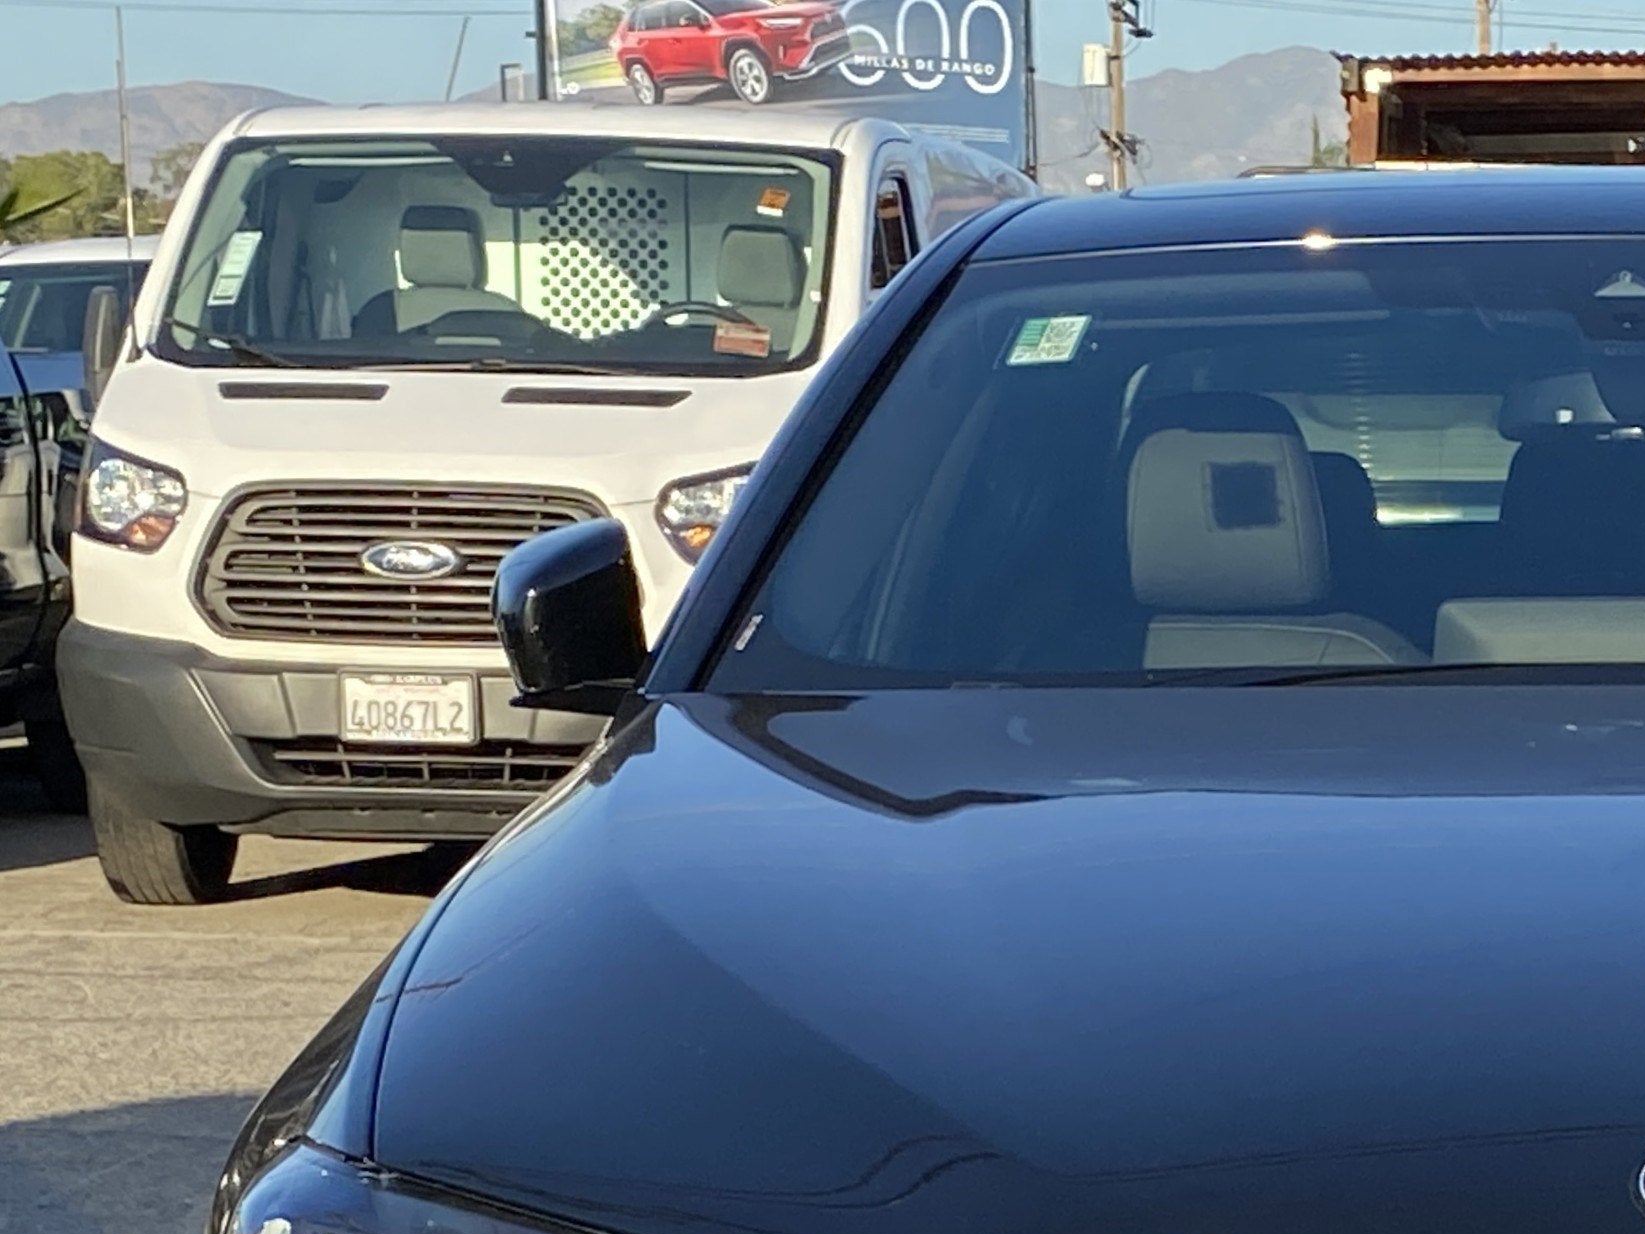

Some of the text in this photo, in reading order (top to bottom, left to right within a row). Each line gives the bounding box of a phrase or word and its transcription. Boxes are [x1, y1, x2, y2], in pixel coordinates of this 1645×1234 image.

[854, 54, 996, 76] MILLAS DE RANGO
[351, 699, 463, 732] 40867L2
